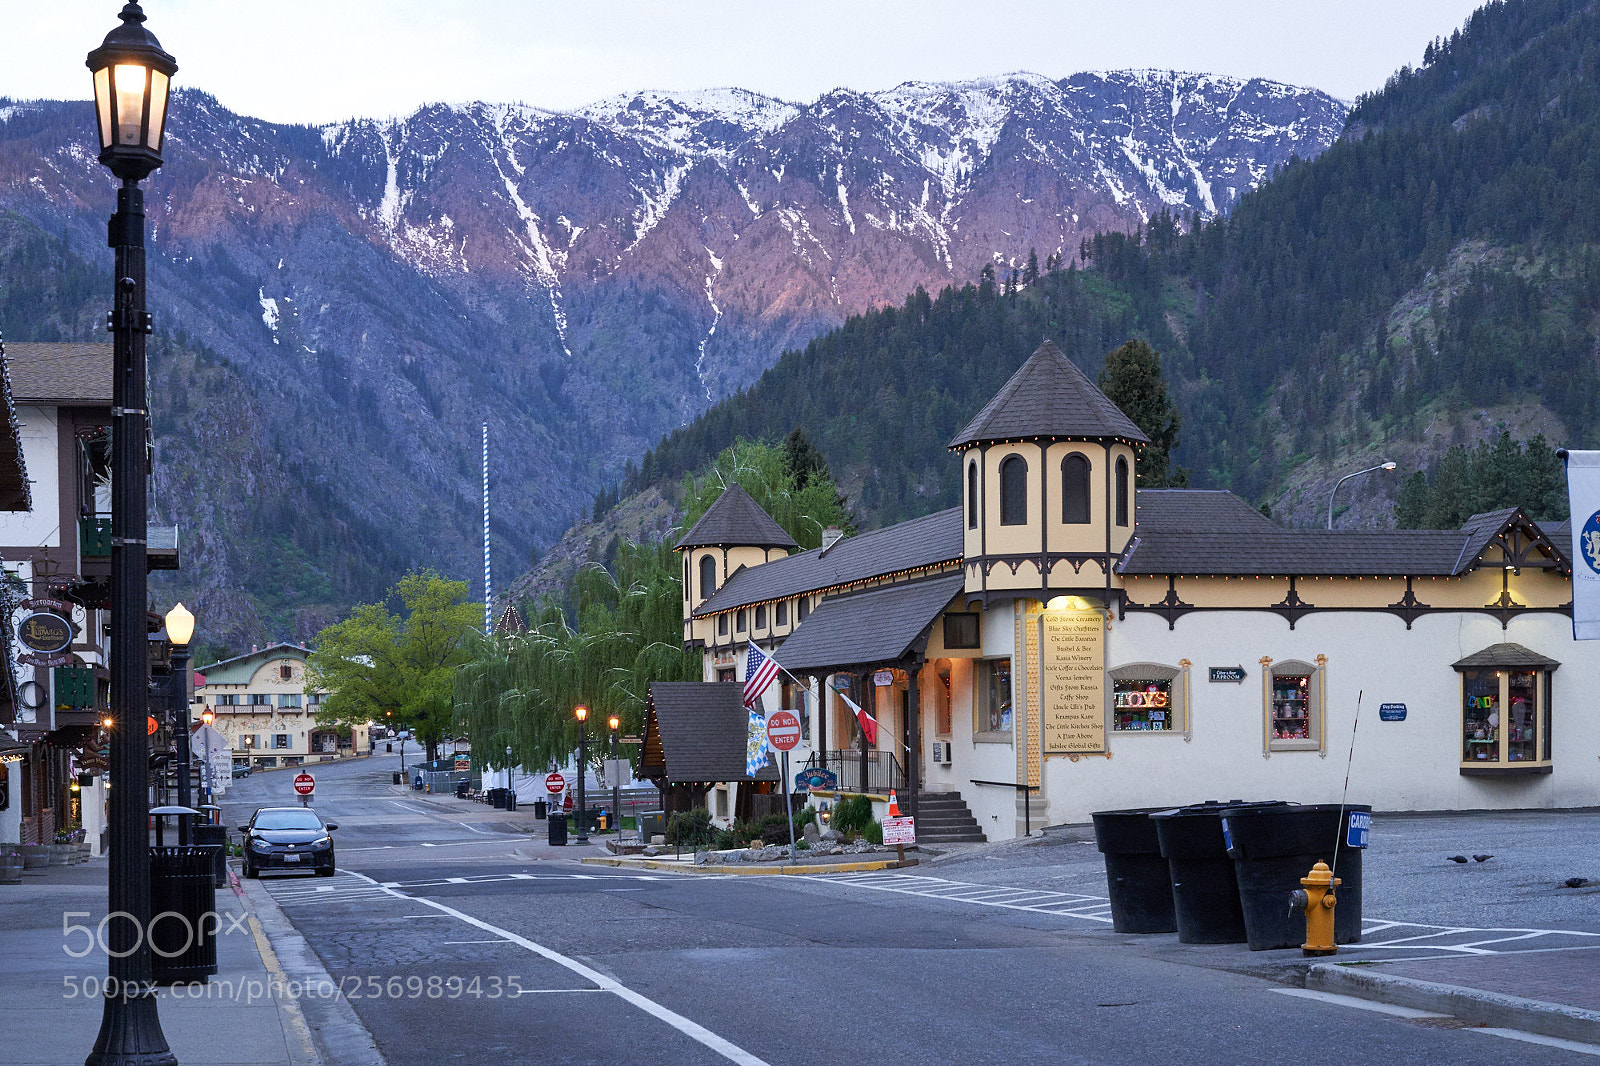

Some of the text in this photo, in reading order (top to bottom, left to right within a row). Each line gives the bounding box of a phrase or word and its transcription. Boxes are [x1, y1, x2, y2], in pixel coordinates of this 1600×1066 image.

[1114, 691, 1168, 708] TOYS
[1468, 695, 1496, 708] CANDY
[804, 769, 830, 780] Jubilee
